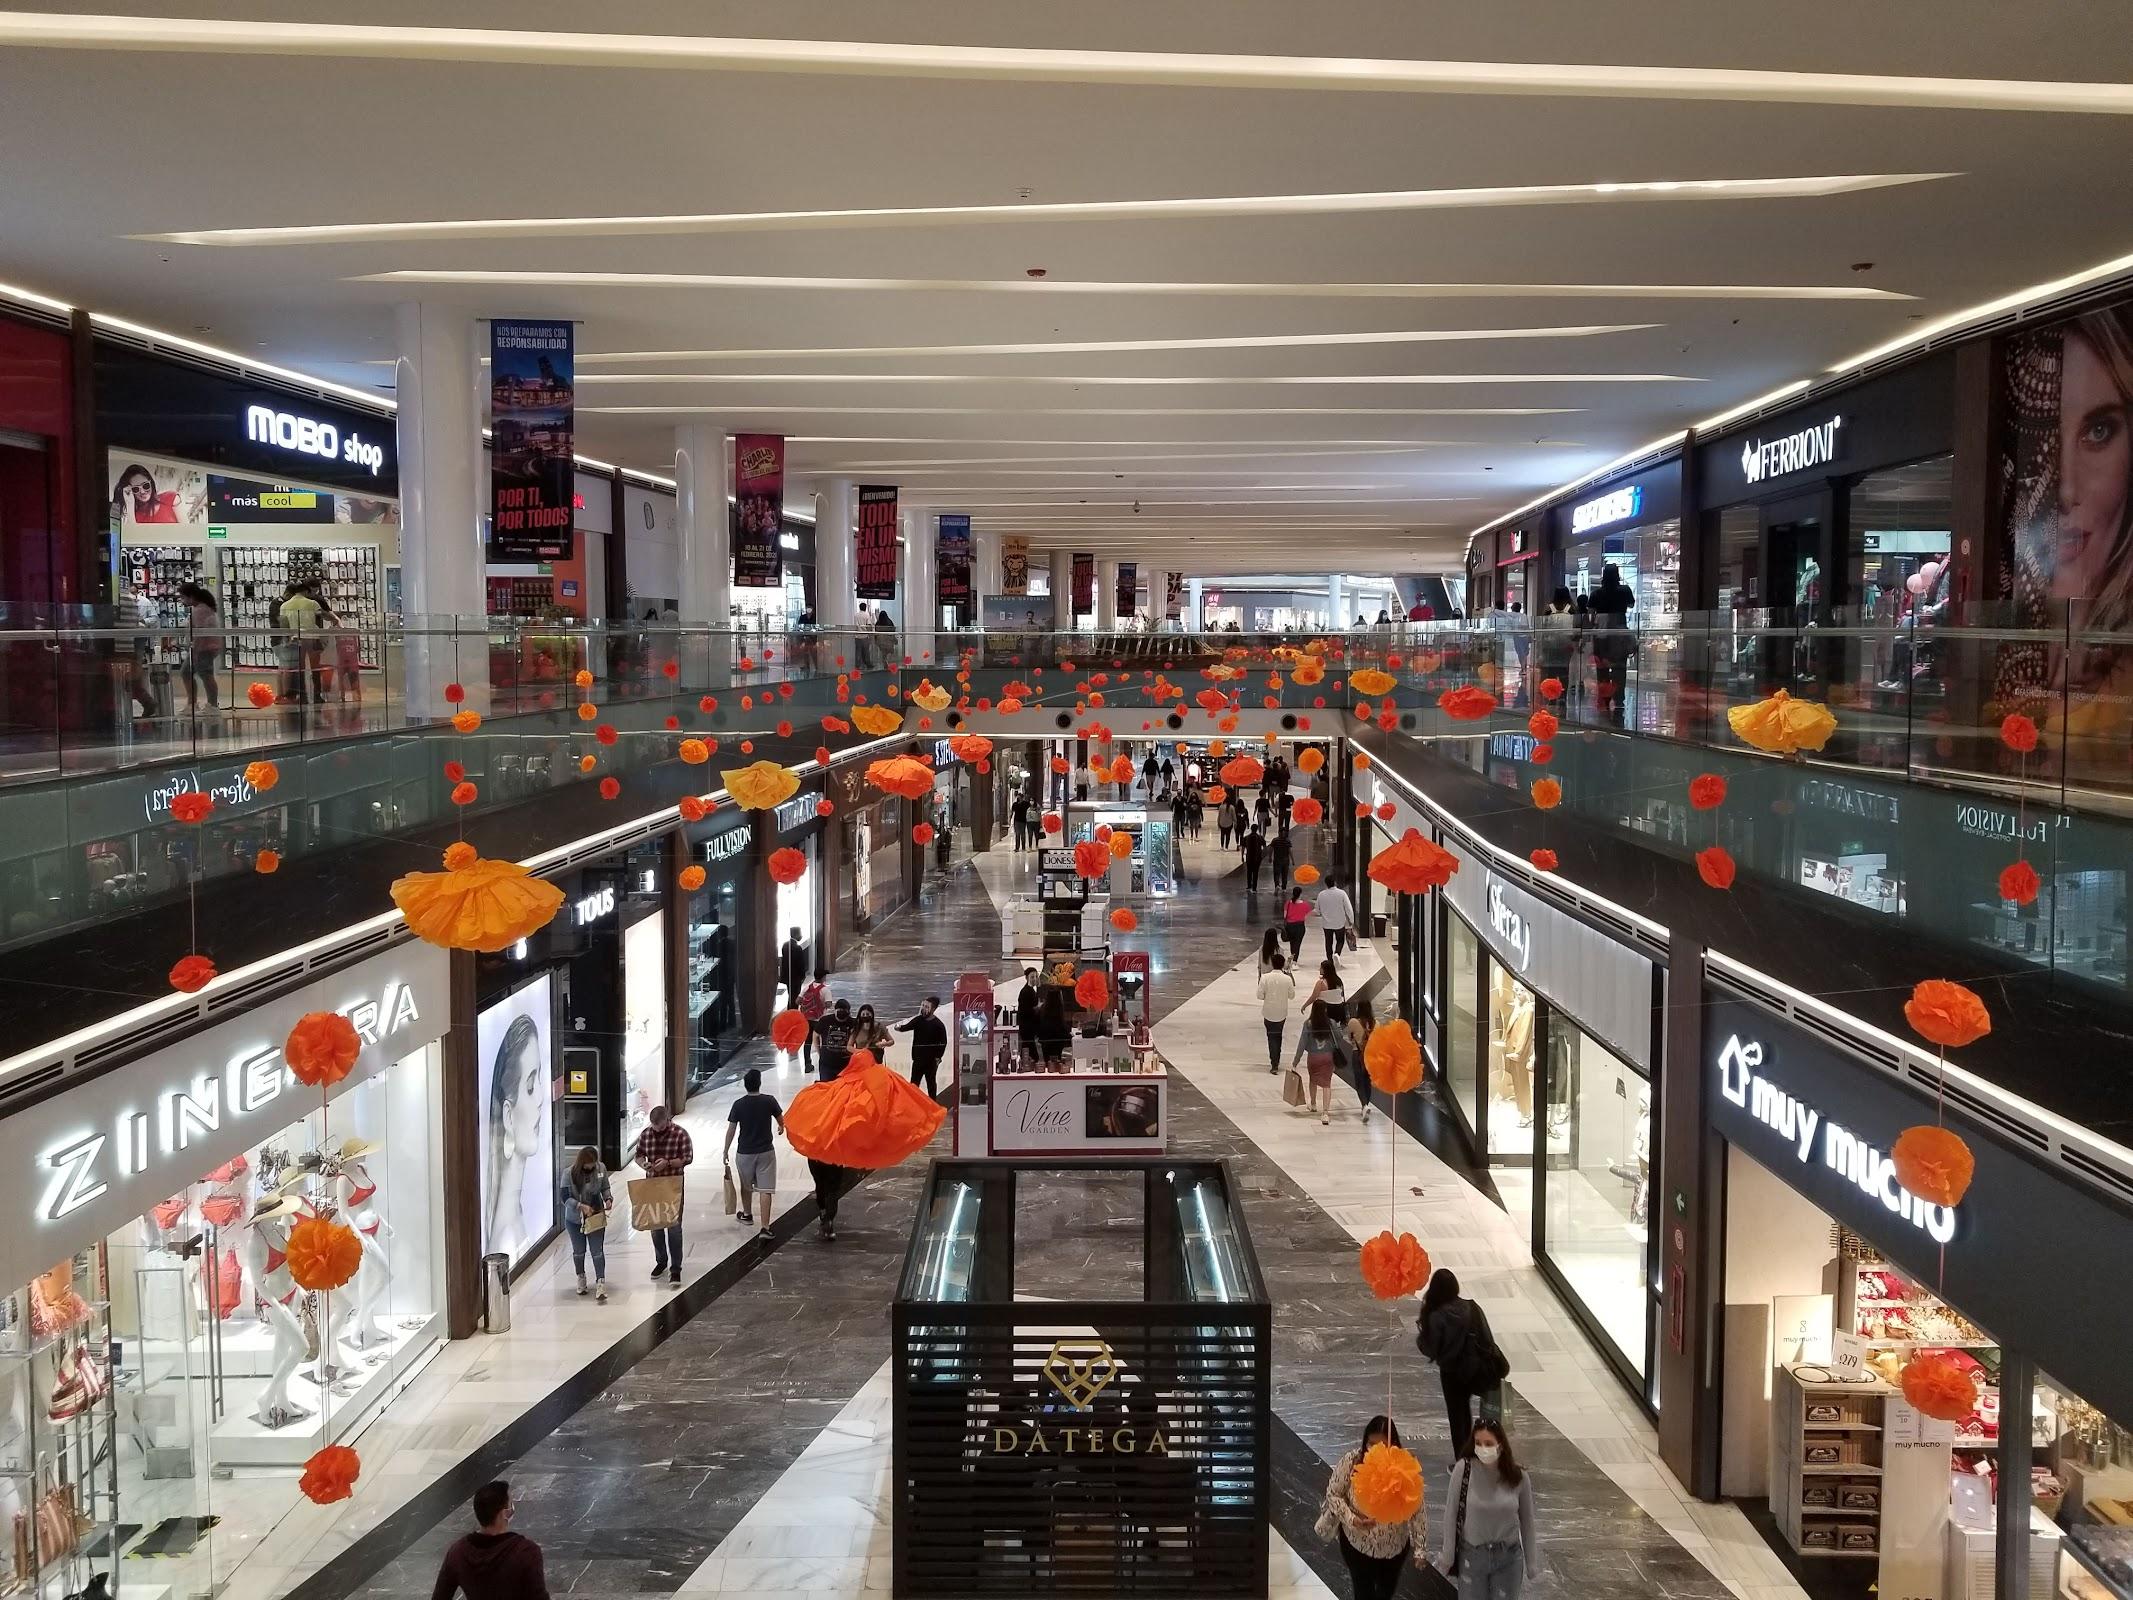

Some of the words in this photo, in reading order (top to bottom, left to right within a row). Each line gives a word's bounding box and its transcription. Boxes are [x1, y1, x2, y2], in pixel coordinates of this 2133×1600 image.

[497, 337, 567, 349] RESPONSABILIDAD
[510, 326, 553, 338] PREPARAMOS
[248, 405, 338, 459] MOBO
[344, 433, 383, 477] shop
[1761, 421, 1834, 480] FERRIONI
[232, 494, 258, 506] más
[266, 495, 292, 506] cool
[498, 488, 525, 508] POR
[527, 487, 544, 509] TI,
[497, 510, 524, 530] POR
[526, 506, 570, 528] TODOS
[859, 502, 897, 527] TODO
[858, 528, 876, 549] EN
[878, 525, 897, 547] UN
[857, 545, 897, 566] MISMO
[858, 563, 897, 585] UGAR
[706, 836, 724, 862] FULL
[725, 824, 752, 852] VISION
[1043, 856, 1076, 865] LIONESS
[575, 887, 615, 926] TOUS
[40, 982, 421, 1221] ZINGRA
[1005, 1089, 1072, 1134] Vine
[1029, 1126, 1071, 1134] GARDEN
[1752, 1076, 1819, 1163] muy
[632, 1201, 680, 1228] ZARA
[993, 1428, 1169, 1453] DATEGA
